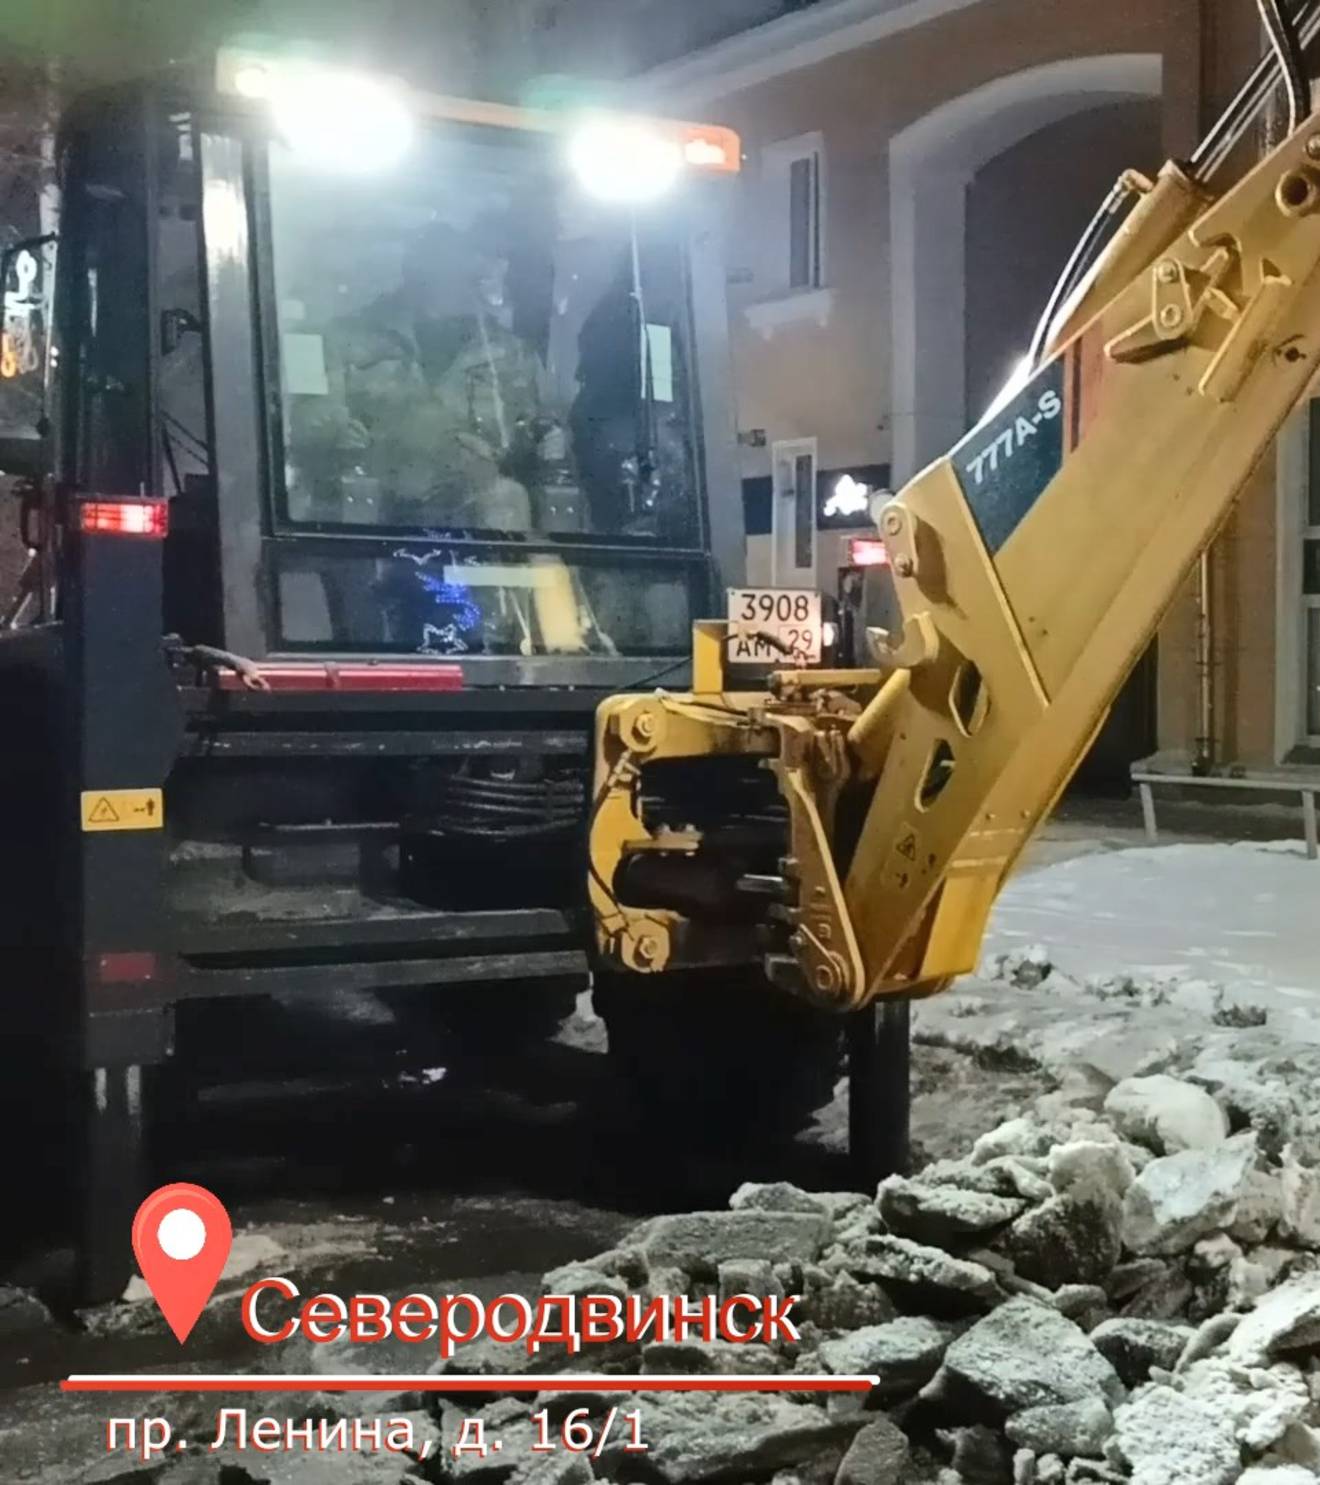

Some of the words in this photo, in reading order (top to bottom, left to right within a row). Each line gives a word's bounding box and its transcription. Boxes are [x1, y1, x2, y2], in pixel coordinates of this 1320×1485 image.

[965, 390, 1061, 484] 777A-S
[741, 594, 809, 622] 3908
[788, 629, 813, 652] 29
